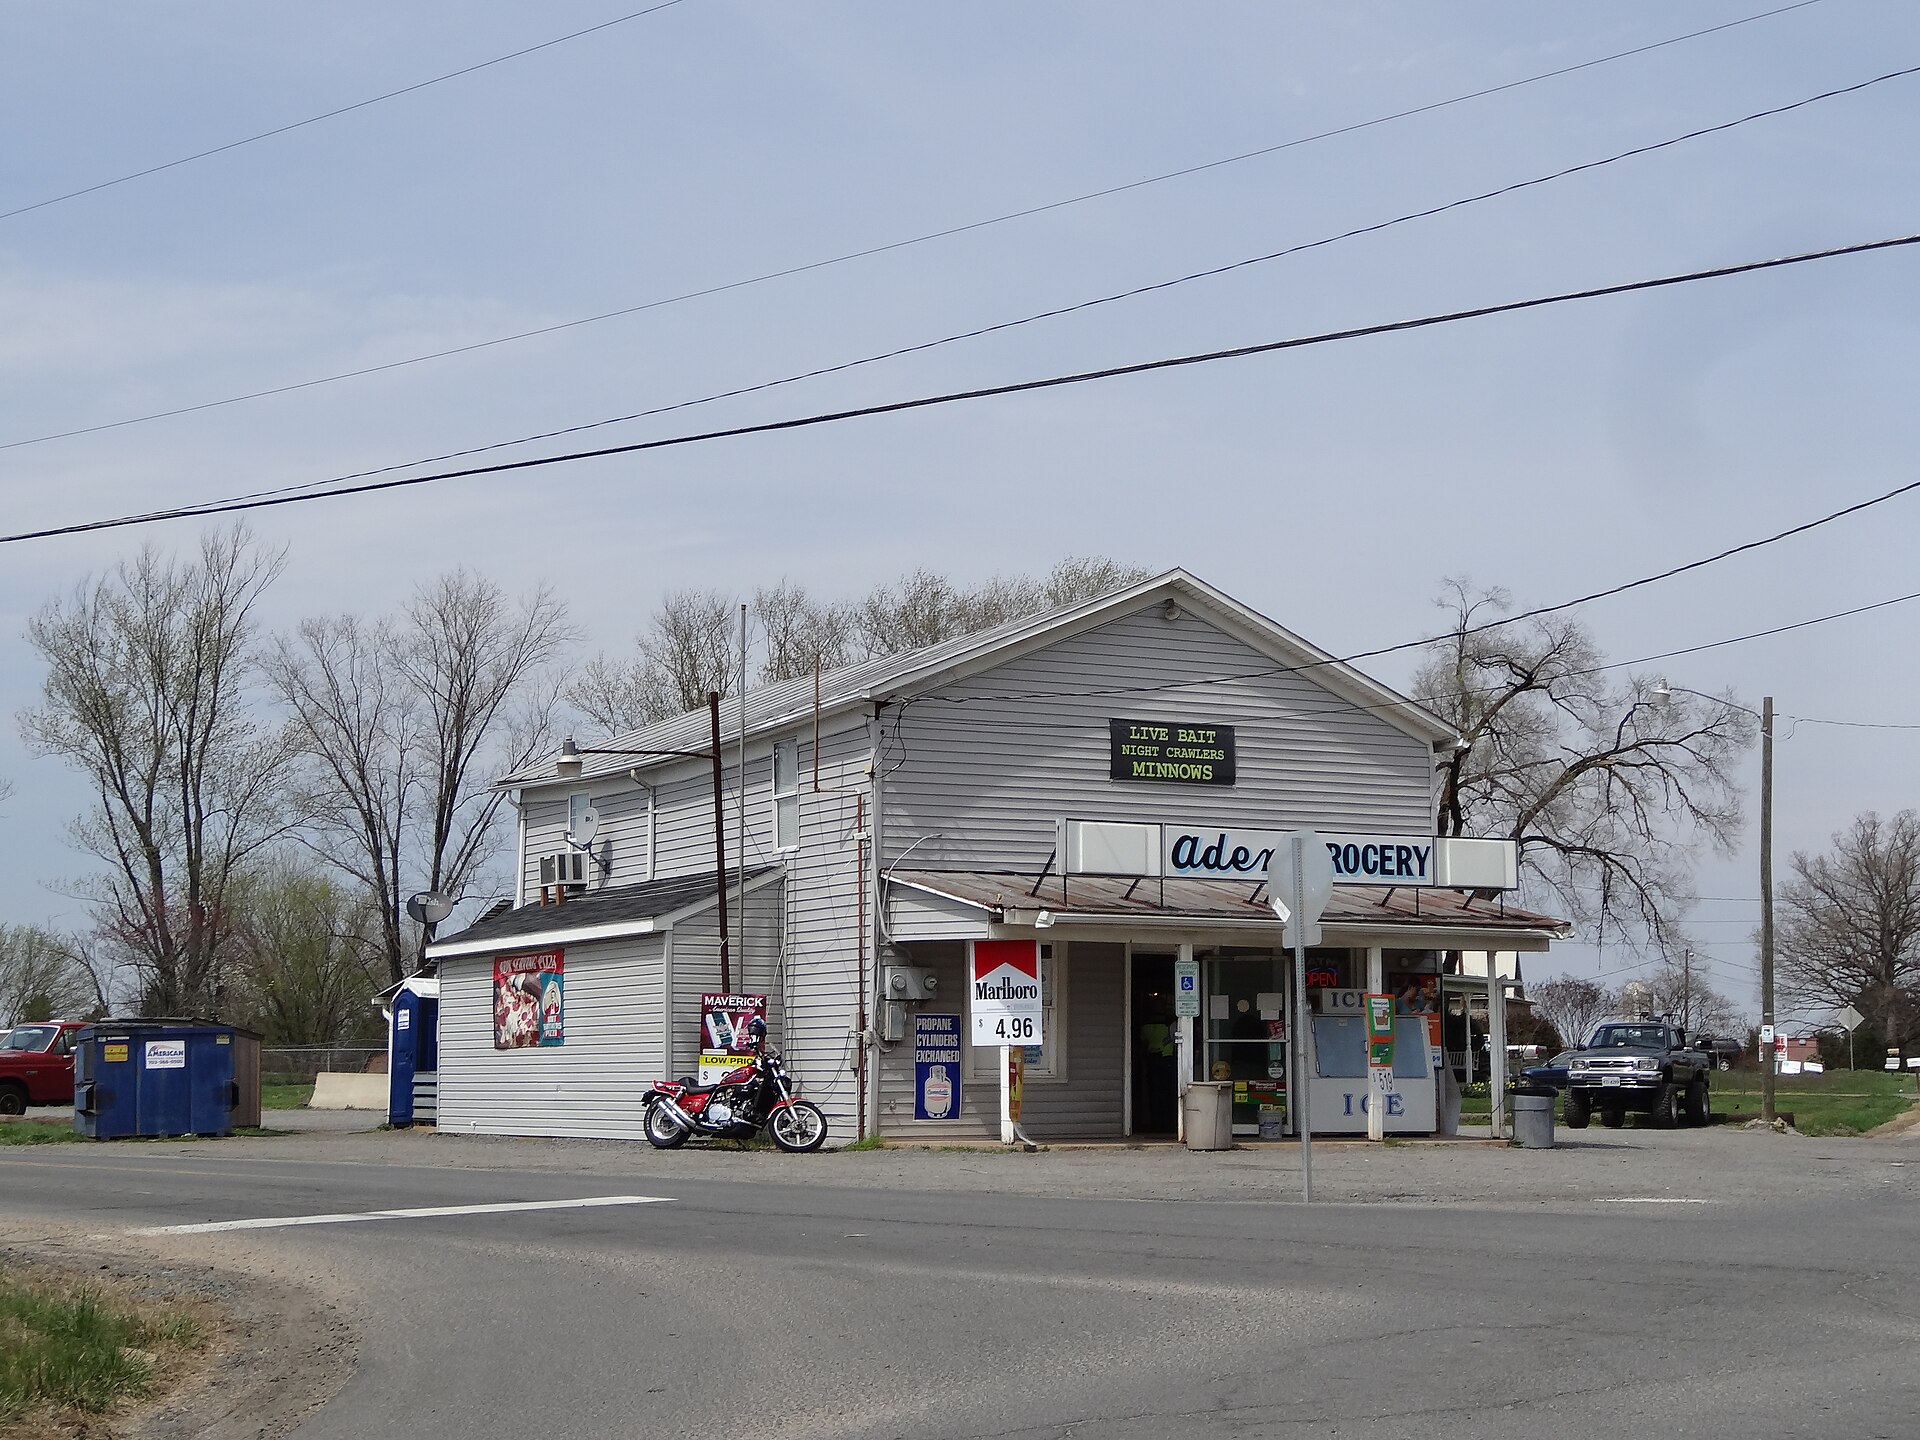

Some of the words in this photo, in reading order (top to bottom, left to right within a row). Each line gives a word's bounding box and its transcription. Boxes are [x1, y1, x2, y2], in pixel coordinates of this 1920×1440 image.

[1129, 726, 1169, 741] LIVE
[1177, 729, 1216, 744] BAIT
[1121, 744, 1159, 757] NIGHT
[1166, 747, 1225, 760] CRAWLERS
[1131, 761, 1213, 780] MINNOWS
[1325, 842, 1431, 878] ROCERY
[975, 977, 1038, 1000] Marlboro
[704, 995, 763, 1007] MAVERICK
[736, 1006, 756, 1014] Quality
[916, 1018, 952, 1031] PROPANE
[978, 1018, 984, 1028] $
[995, 1017, 1033, 1039] 4.96
[916, 1034, 958, 1047] CYLINDERS
[730, 1057, 756, 1066] PRIC
[916, 1050, 960, 1063] EXCHANGED
[702, 1070, 709, 1081] $
